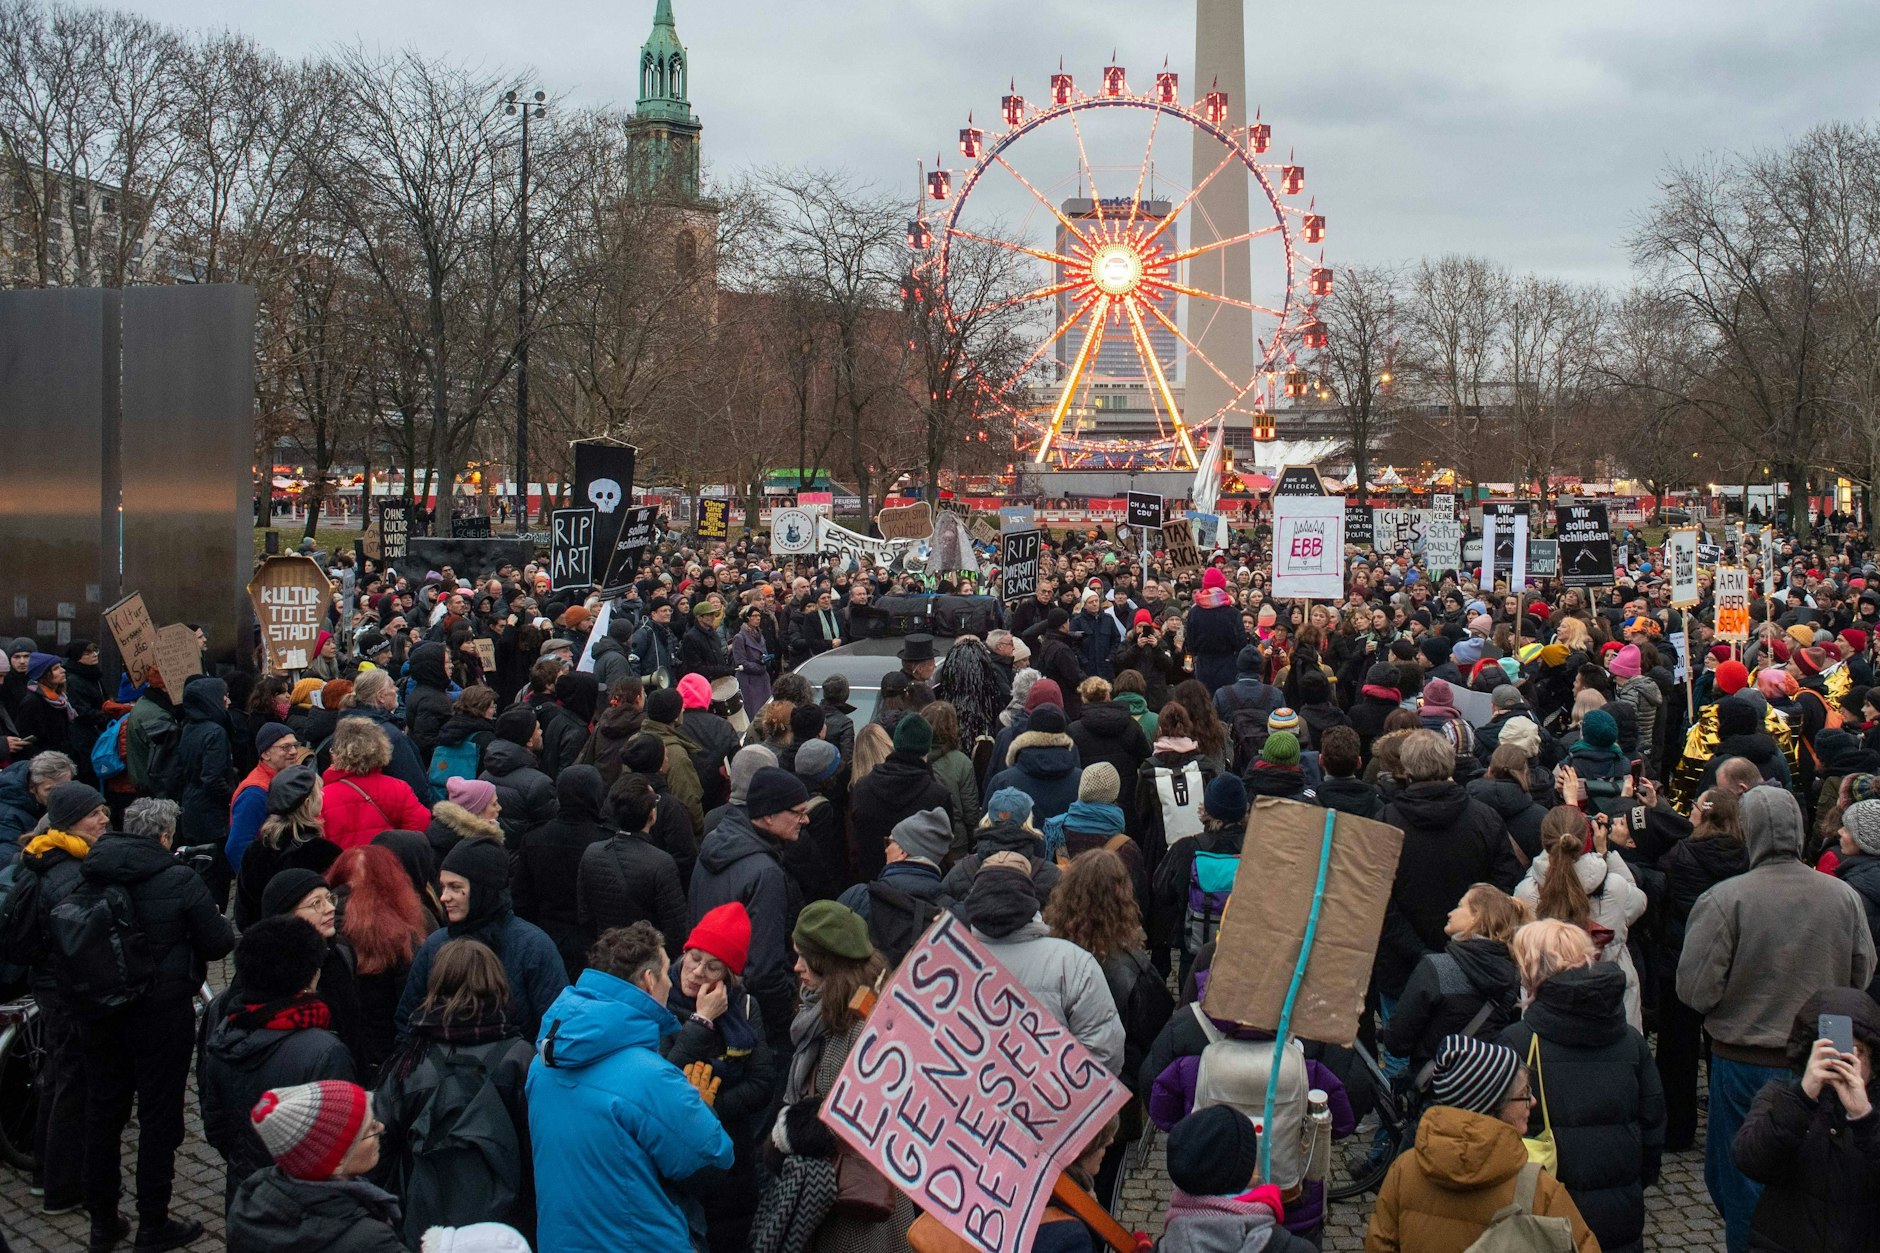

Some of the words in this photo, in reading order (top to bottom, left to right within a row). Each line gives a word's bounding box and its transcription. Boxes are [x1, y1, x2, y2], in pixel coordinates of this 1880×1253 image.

[704, 500, 726, 508] Ohne
[938, 499, 970, 515] KANN
[1497, 505, 1514, 514] Wir
[384, 508, 405, 520] OHNE
[637, 510, 650, 522] Wir
[1381, 512, 1398, 524] ICH
[1403, 512, 1420, 524] BIN
[1571, 508, 1590, 518] Wir
[555, 516, 590, 546] RIP
[628, 524, 649, 537] sollen
[701, 520, 725, 528] nichts
[1429, 525, 1458, 538] SERI
[1566, 521, 1599, 531] sollen
[826, 528, 868, 549] ERST
[1165, 522, 1192, 542] TAX
[1345, 531, 1371, 539] POLITIK
[1397, 523, 1421, 542] ES
[1560, 531, 1609, 542] schließen
[1008, 537, 1035, 562] RIP
[1291, 538, 1322, 558] EBB
[1380, 540, 1419, 552] WERT
[555, 546, 589, 579] ART
[1169, 546, 1199, 568] RICH
[1676, 551, 1693, 564] STADT
[1004, 559, 1036, 580] DIVERSITY
[1676, 564, 1692, 577] RAUM
[1720, 575, 1743, 590] ARM
[1719, 596, 1743, 610] ABER
[111, 606, 143, 634] Kultur
[269, 605, 317, 622] TOTE
[1719, 616, 1748, 632] SEXY
[269, 624, 320, 641] STADT
[134, 642, 148, 657] die
[830, 1032, 908, 1148] ES
[894, 916, 984, 1030] IST
[886, 970, 1027, 1184] GENUG
[925, 1012, 1060, 1215] DIESER
[965, 1044, 1107, 1252] BETRUG
